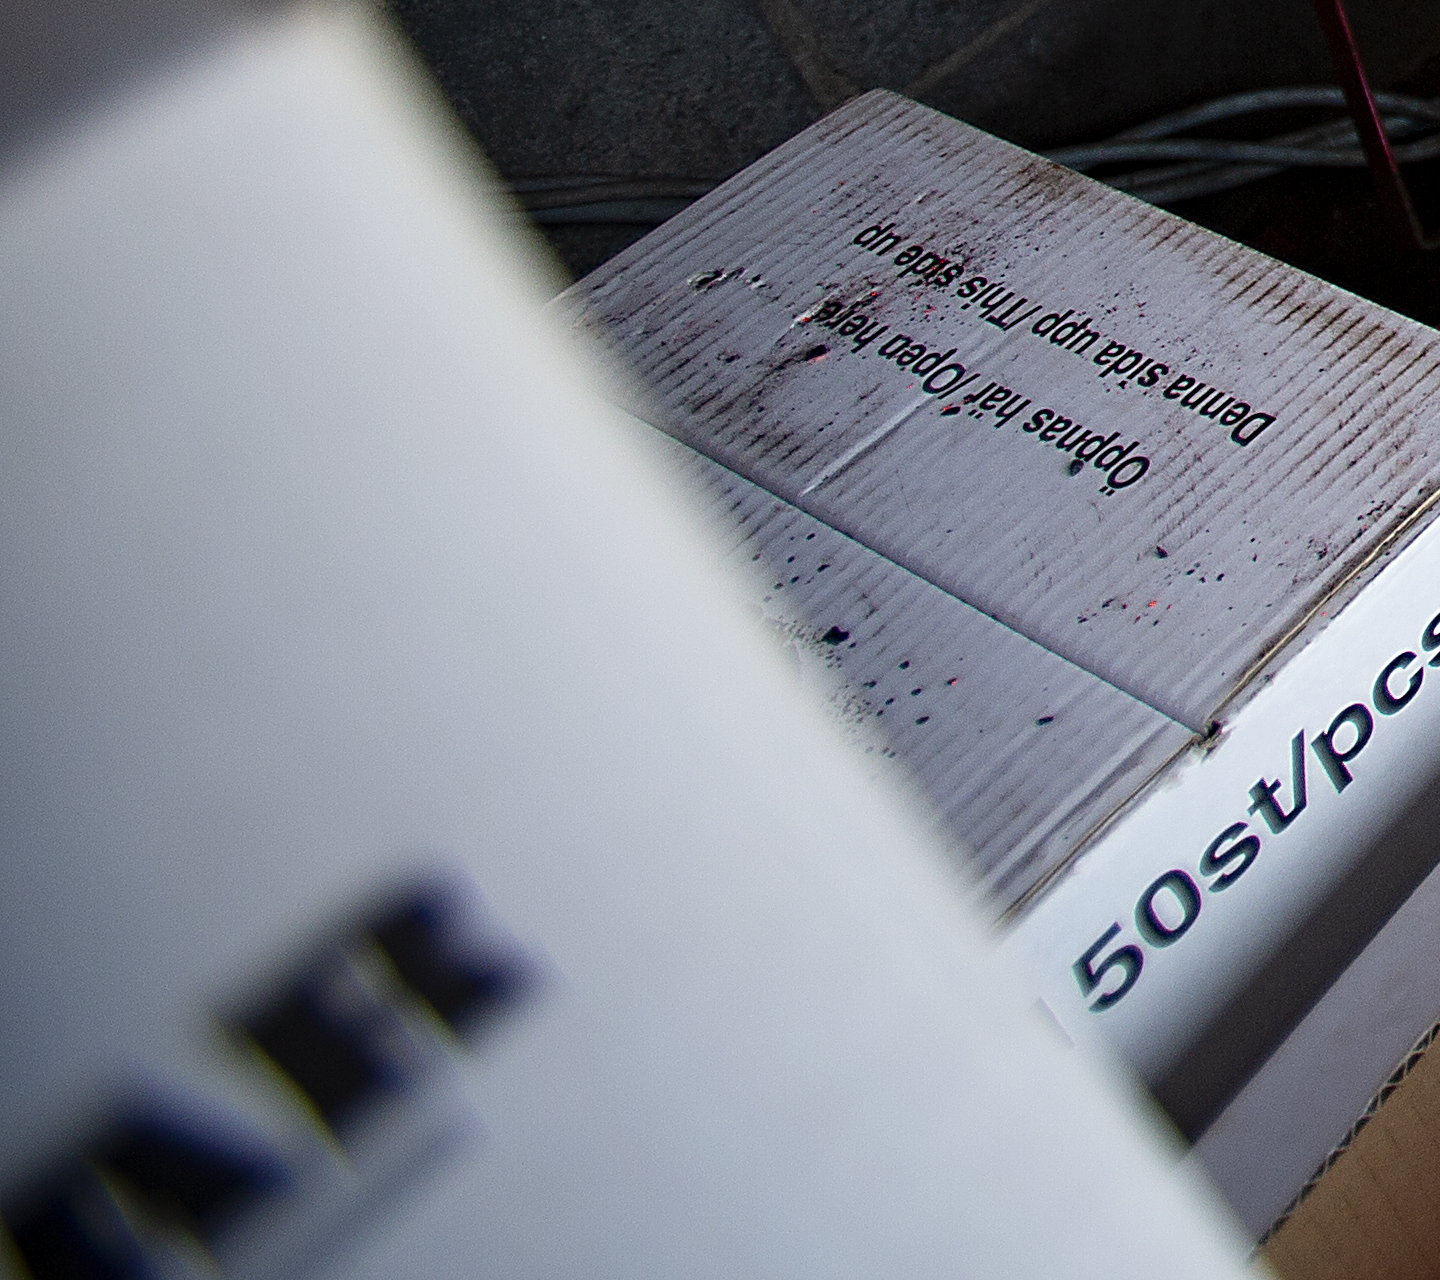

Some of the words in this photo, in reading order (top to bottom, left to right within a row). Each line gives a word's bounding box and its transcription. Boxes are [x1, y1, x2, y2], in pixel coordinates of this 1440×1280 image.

[852, 222, 898, 257] up
[893, 244, 965, 288] side
[814, 299, 881, 354] here
[956, 275, 1044, 333] /This
[1031, 309, 1101, 358] upp
[877, 334, 982, 400] /Open
[1092, 337, 1170, 390] sida
[964, 382, 1032, 429] här
[1162, 374, 1278, 447] Denna
[1021, 408, 1151, 497] Öppnas
